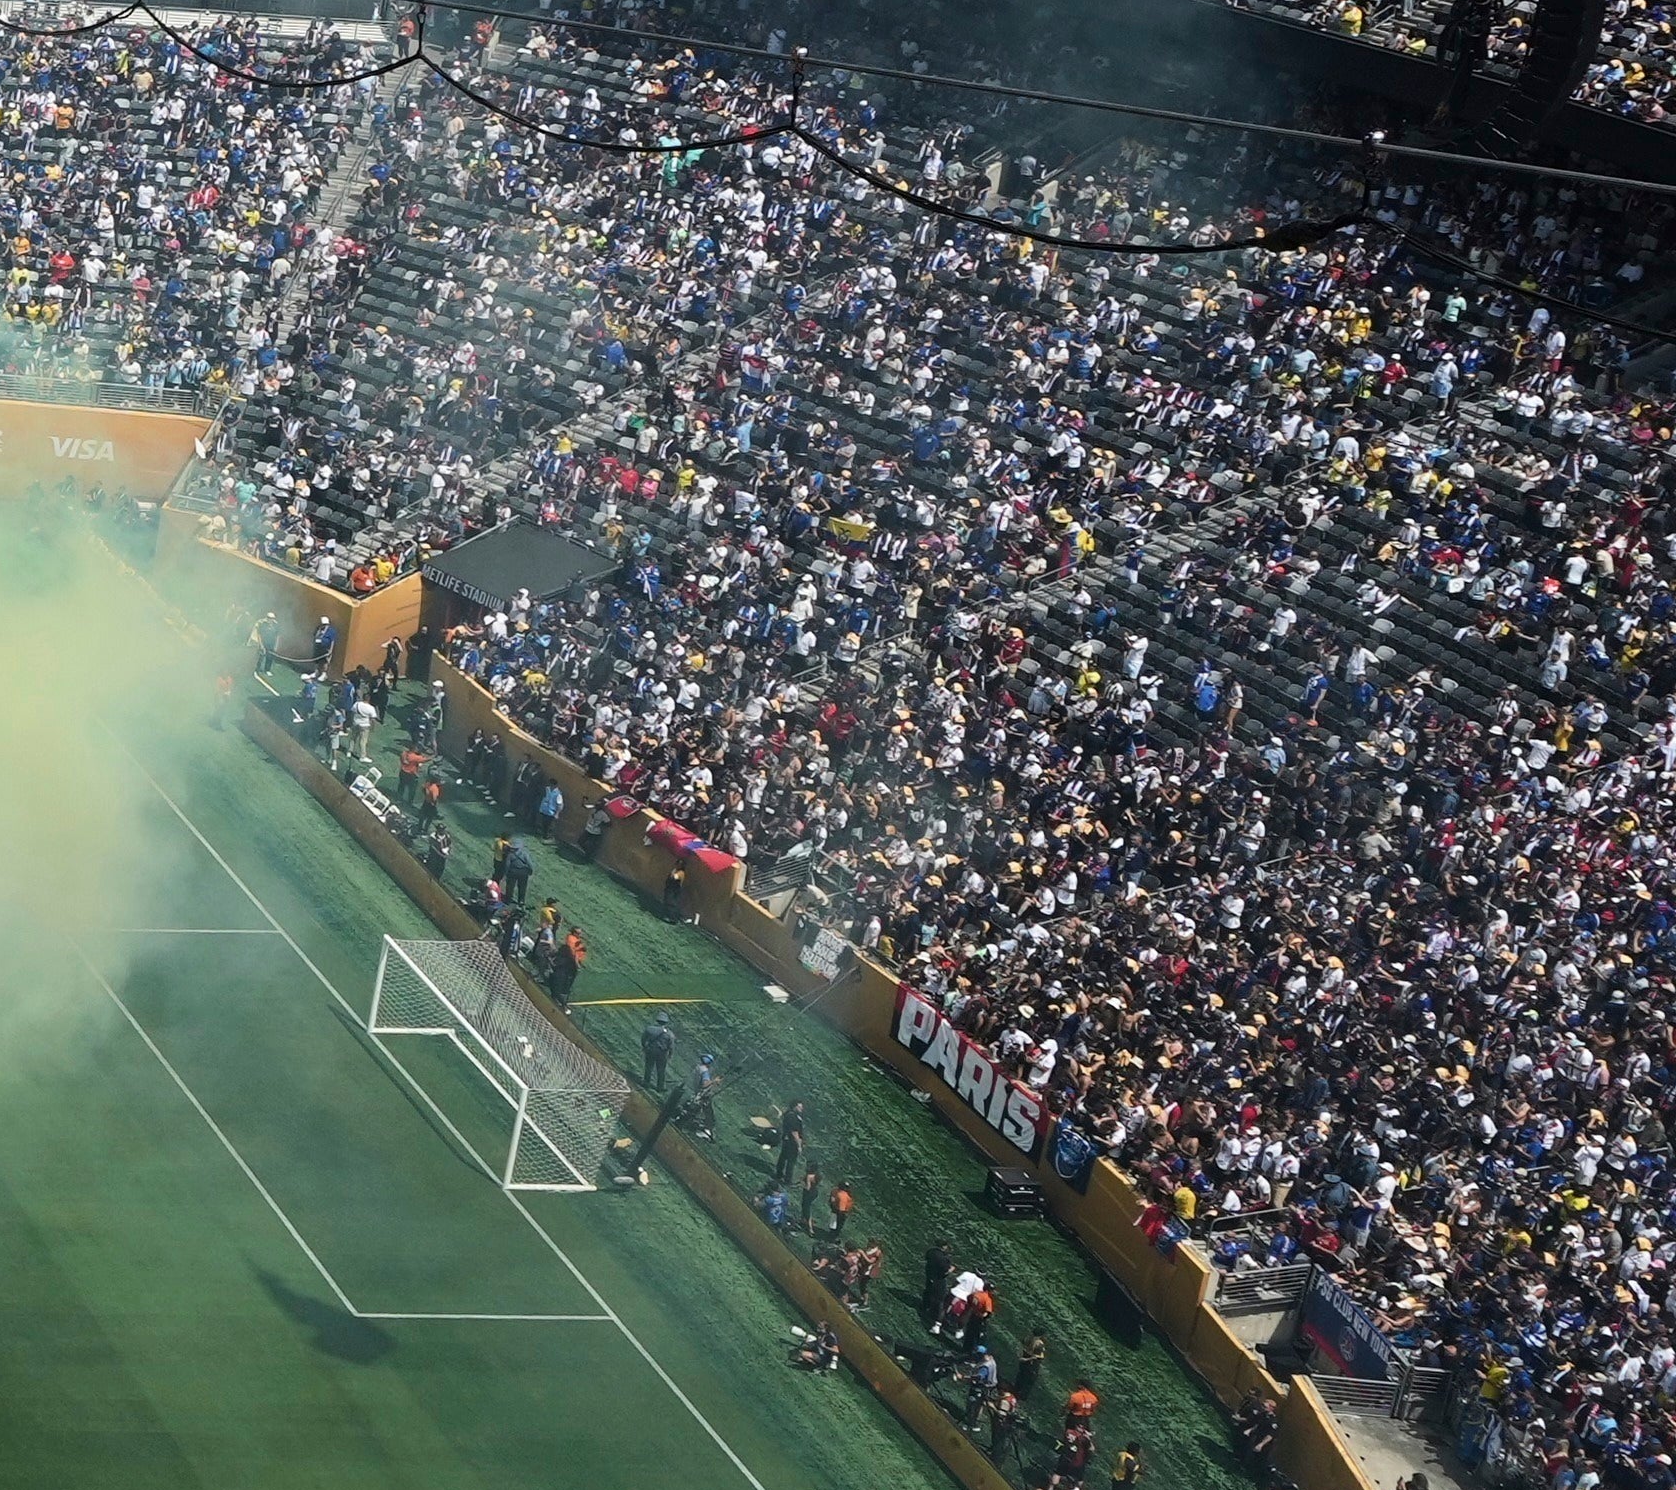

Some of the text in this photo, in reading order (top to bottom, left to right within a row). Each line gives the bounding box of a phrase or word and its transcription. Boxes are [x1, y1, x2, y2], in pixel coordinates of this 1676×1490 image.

[51, 436, 116, 461] VISA
[422, 563, 506, 613] METLIFE STADIUM
[896, 988, 1041, 1153] PARIS
[1315, 1274, 1391, 1362] PSG CLUB NEW YORK
